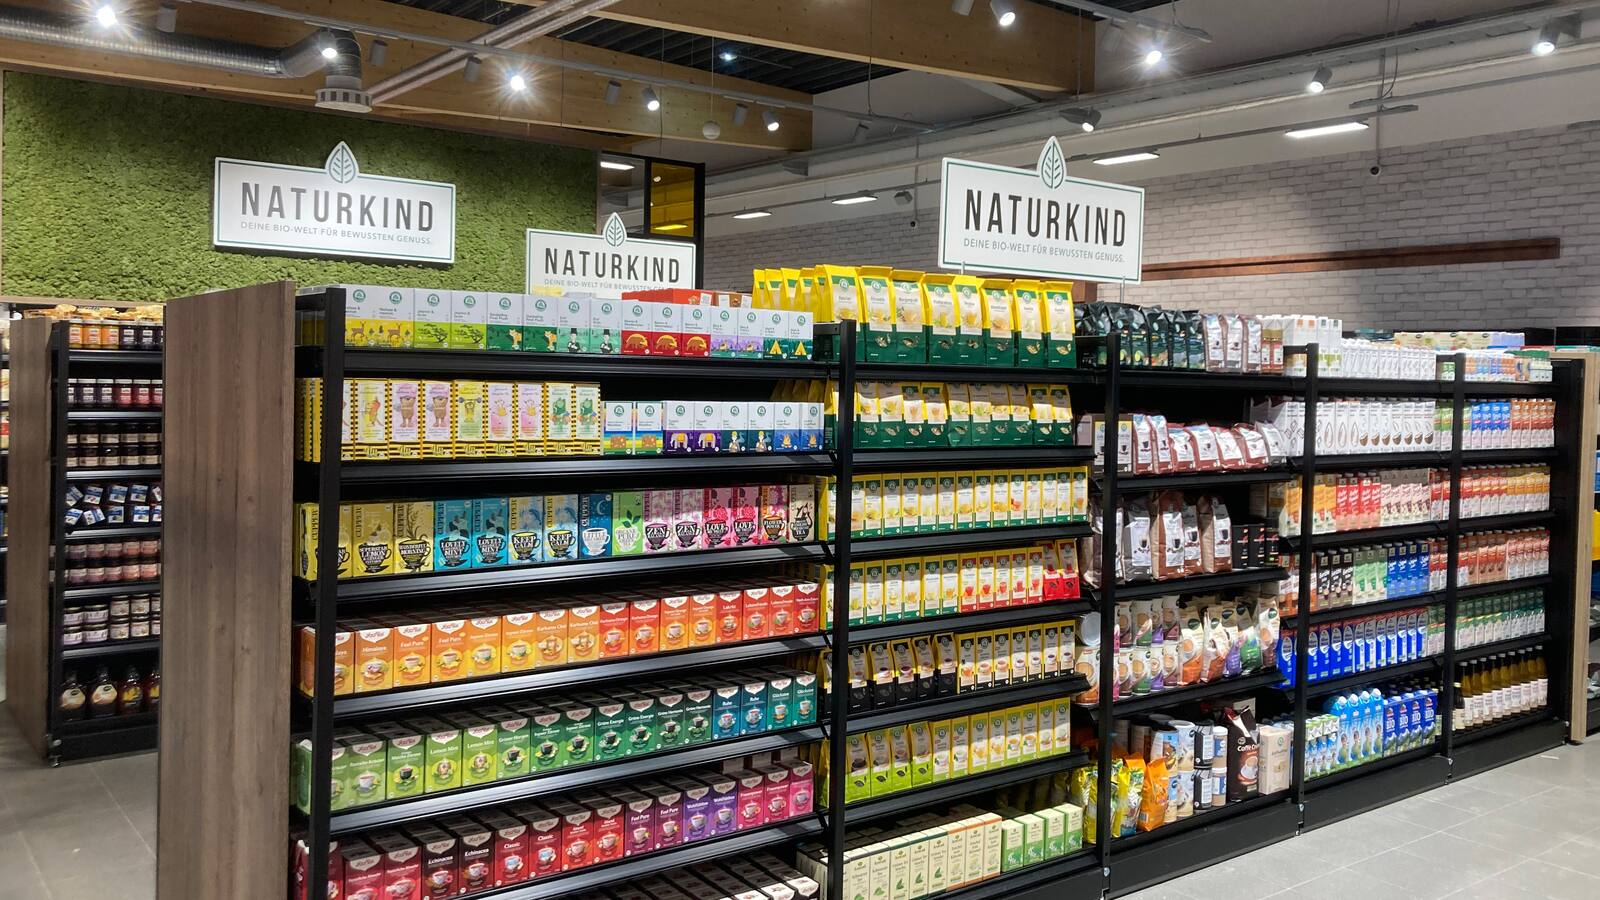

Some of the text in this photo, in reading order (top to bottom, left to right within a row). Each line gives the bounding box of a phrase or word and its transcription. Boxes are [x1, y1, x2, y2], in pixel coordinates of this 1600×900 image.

[241, 182, 433, 232] NATURKIND
[965, 189, 1126, 249] NATURKIND
[241, 221, 271, 231] DEINE
[273, 224, 318, 235] BIO-WELT
[320, 226, 338, 237] FÜR
[341, 230, 394, 242] BEWUSSTEN
[964, 238, 1125, 263] DEINE BIO-WELT FÜR BEWUSSTEN GENUSS.
[545, 247, 680, 283] NATURKIND
[567, 280, 598, 288] BIO-WELT
[646, 527, 666, 535] ZEN
[677, 525, 696, 533] ZEN
[464, 848, 489, 857] Echinacea
[428, 856, 454, 865] Echinacea
